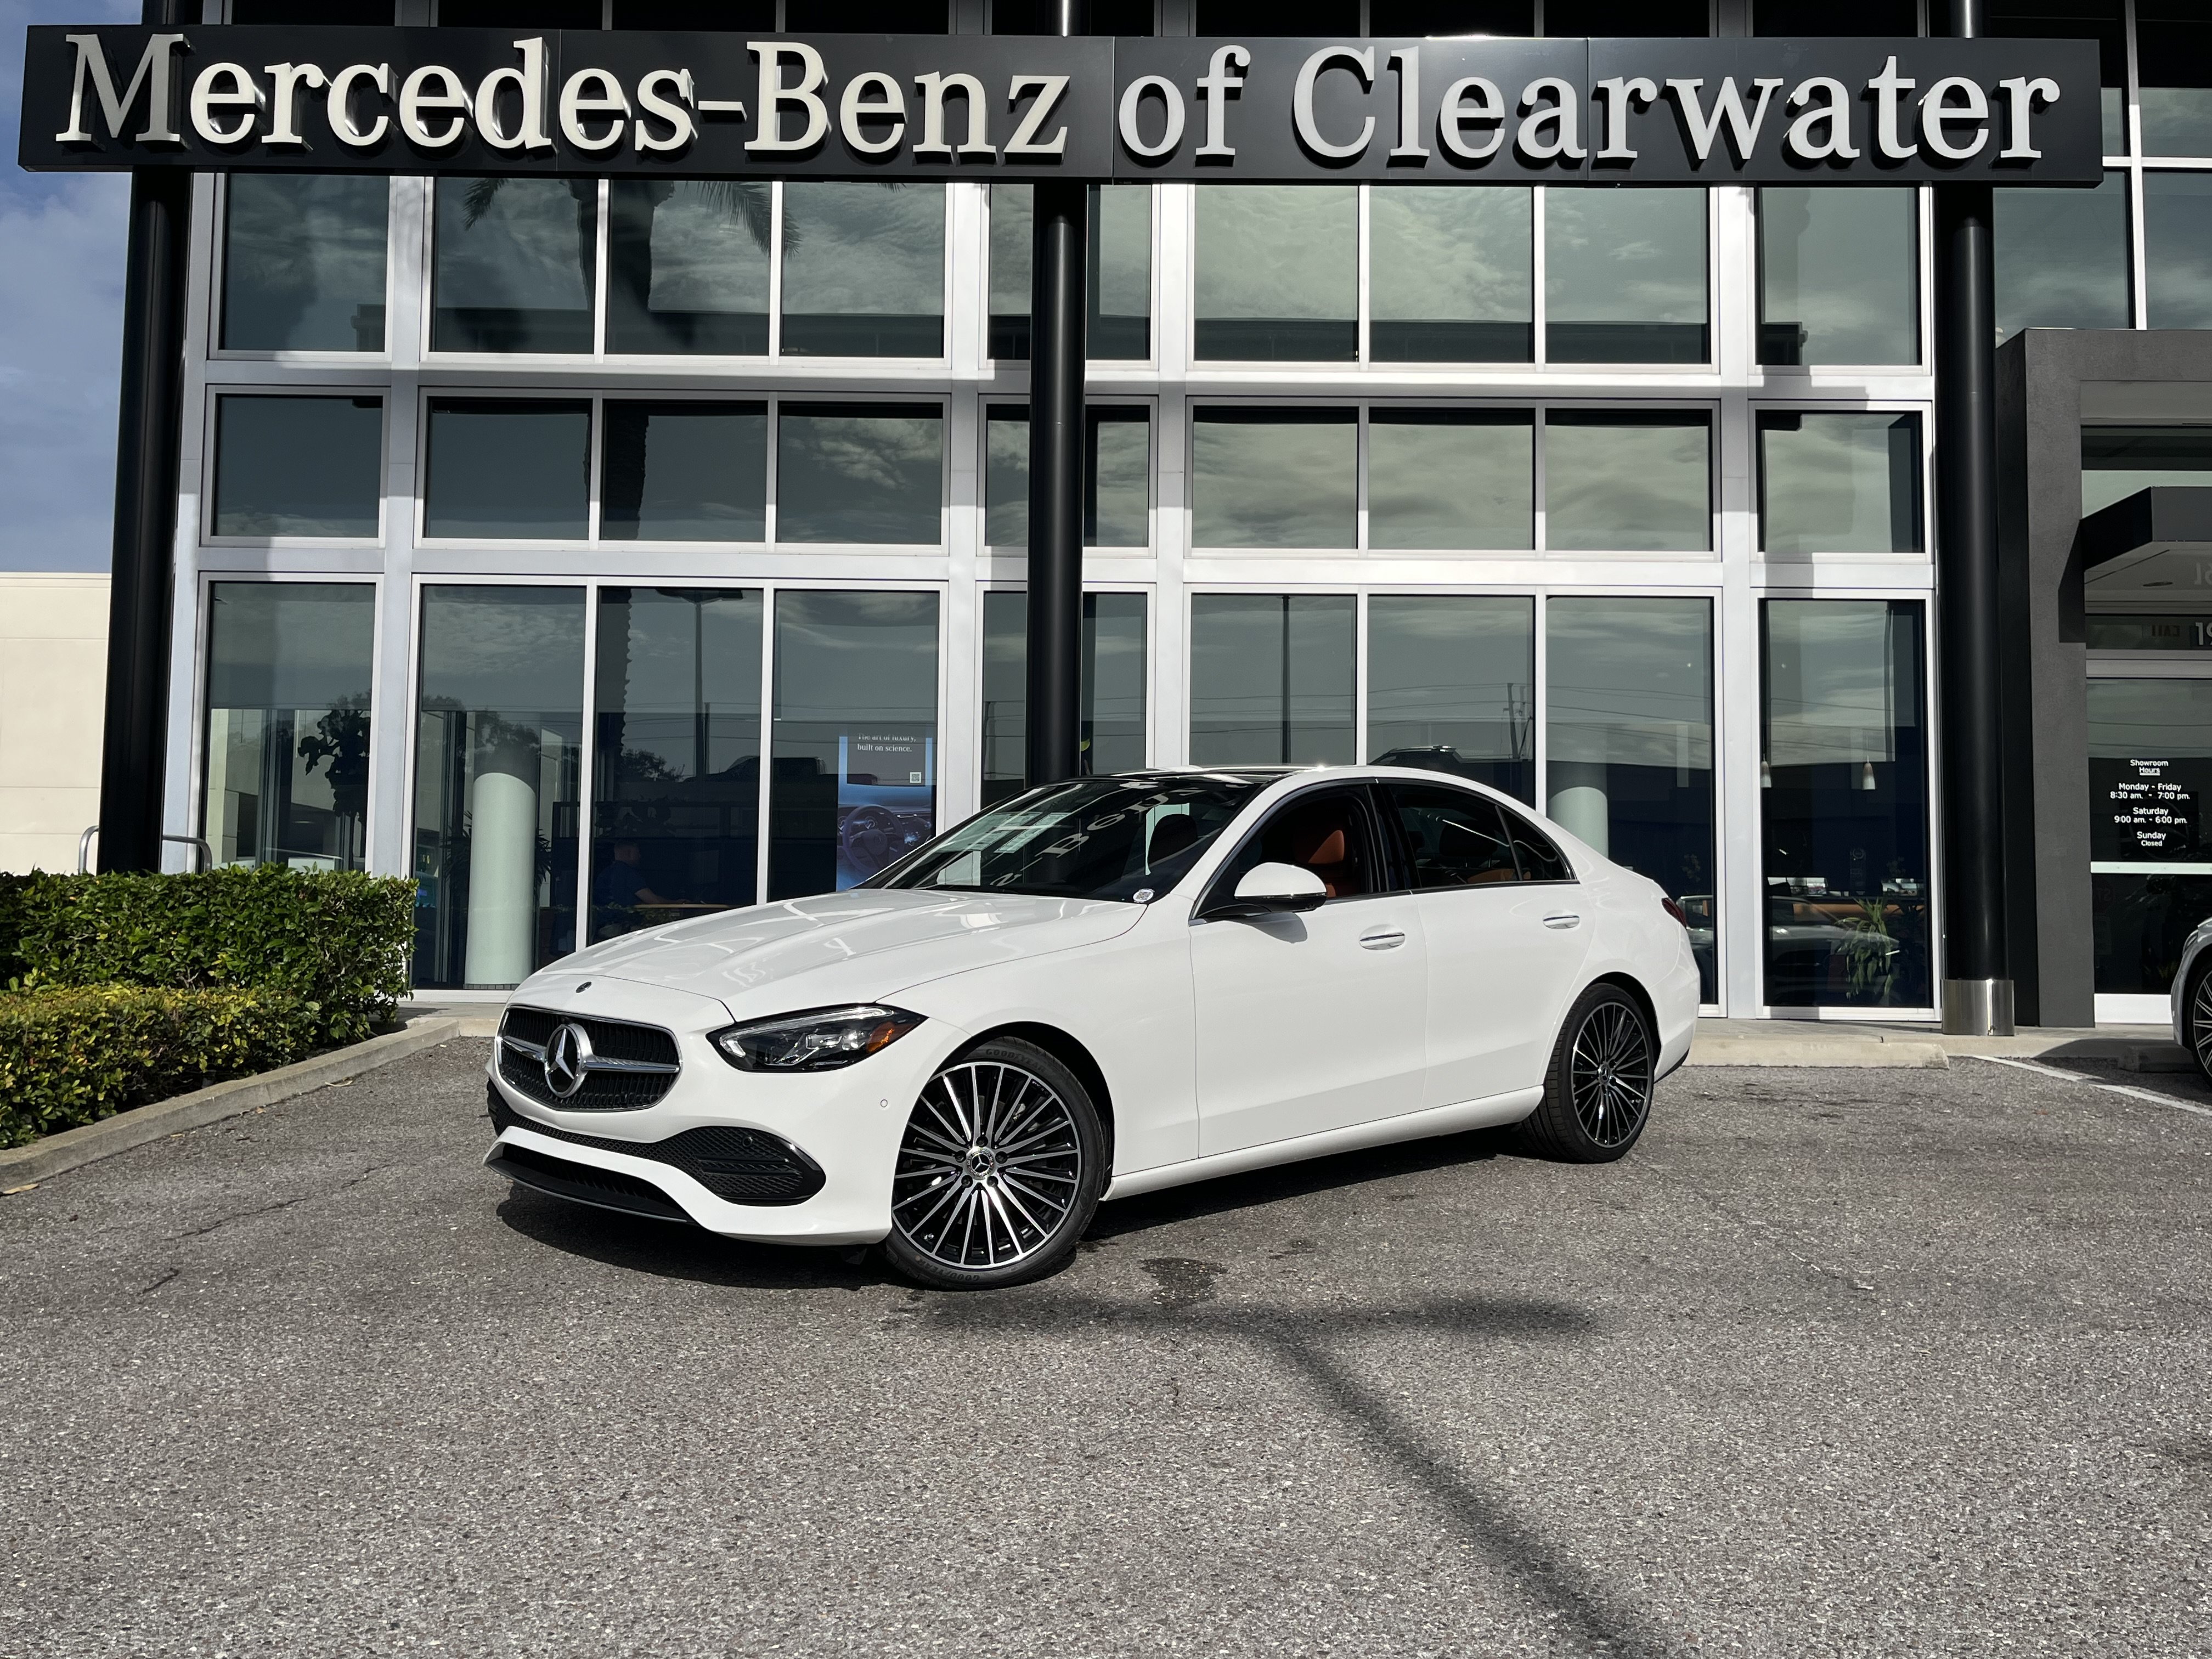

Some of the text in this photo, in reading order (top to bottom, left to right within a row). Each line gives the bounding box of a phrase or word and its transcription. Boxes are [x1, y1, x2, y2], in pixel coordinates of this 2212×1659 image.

[55, 33, 2061, 160] Mercedes-Benz of Clearwater
[885, 744, 912, 753] science.
[2118, 782, 2149, 792] Monday
[2157, 783, 2182, 792] Friday
[2110, 791, 2128, 799] 8:30
[2177, 793, 2191, 801] pm.
[2132, 807, 2169, 816] Saturday
[2114, 815, 2131, 823] 9:00
[2155, 816, 2172, 824] 6:00
[2136, 831, 2166, 840] Sunday
